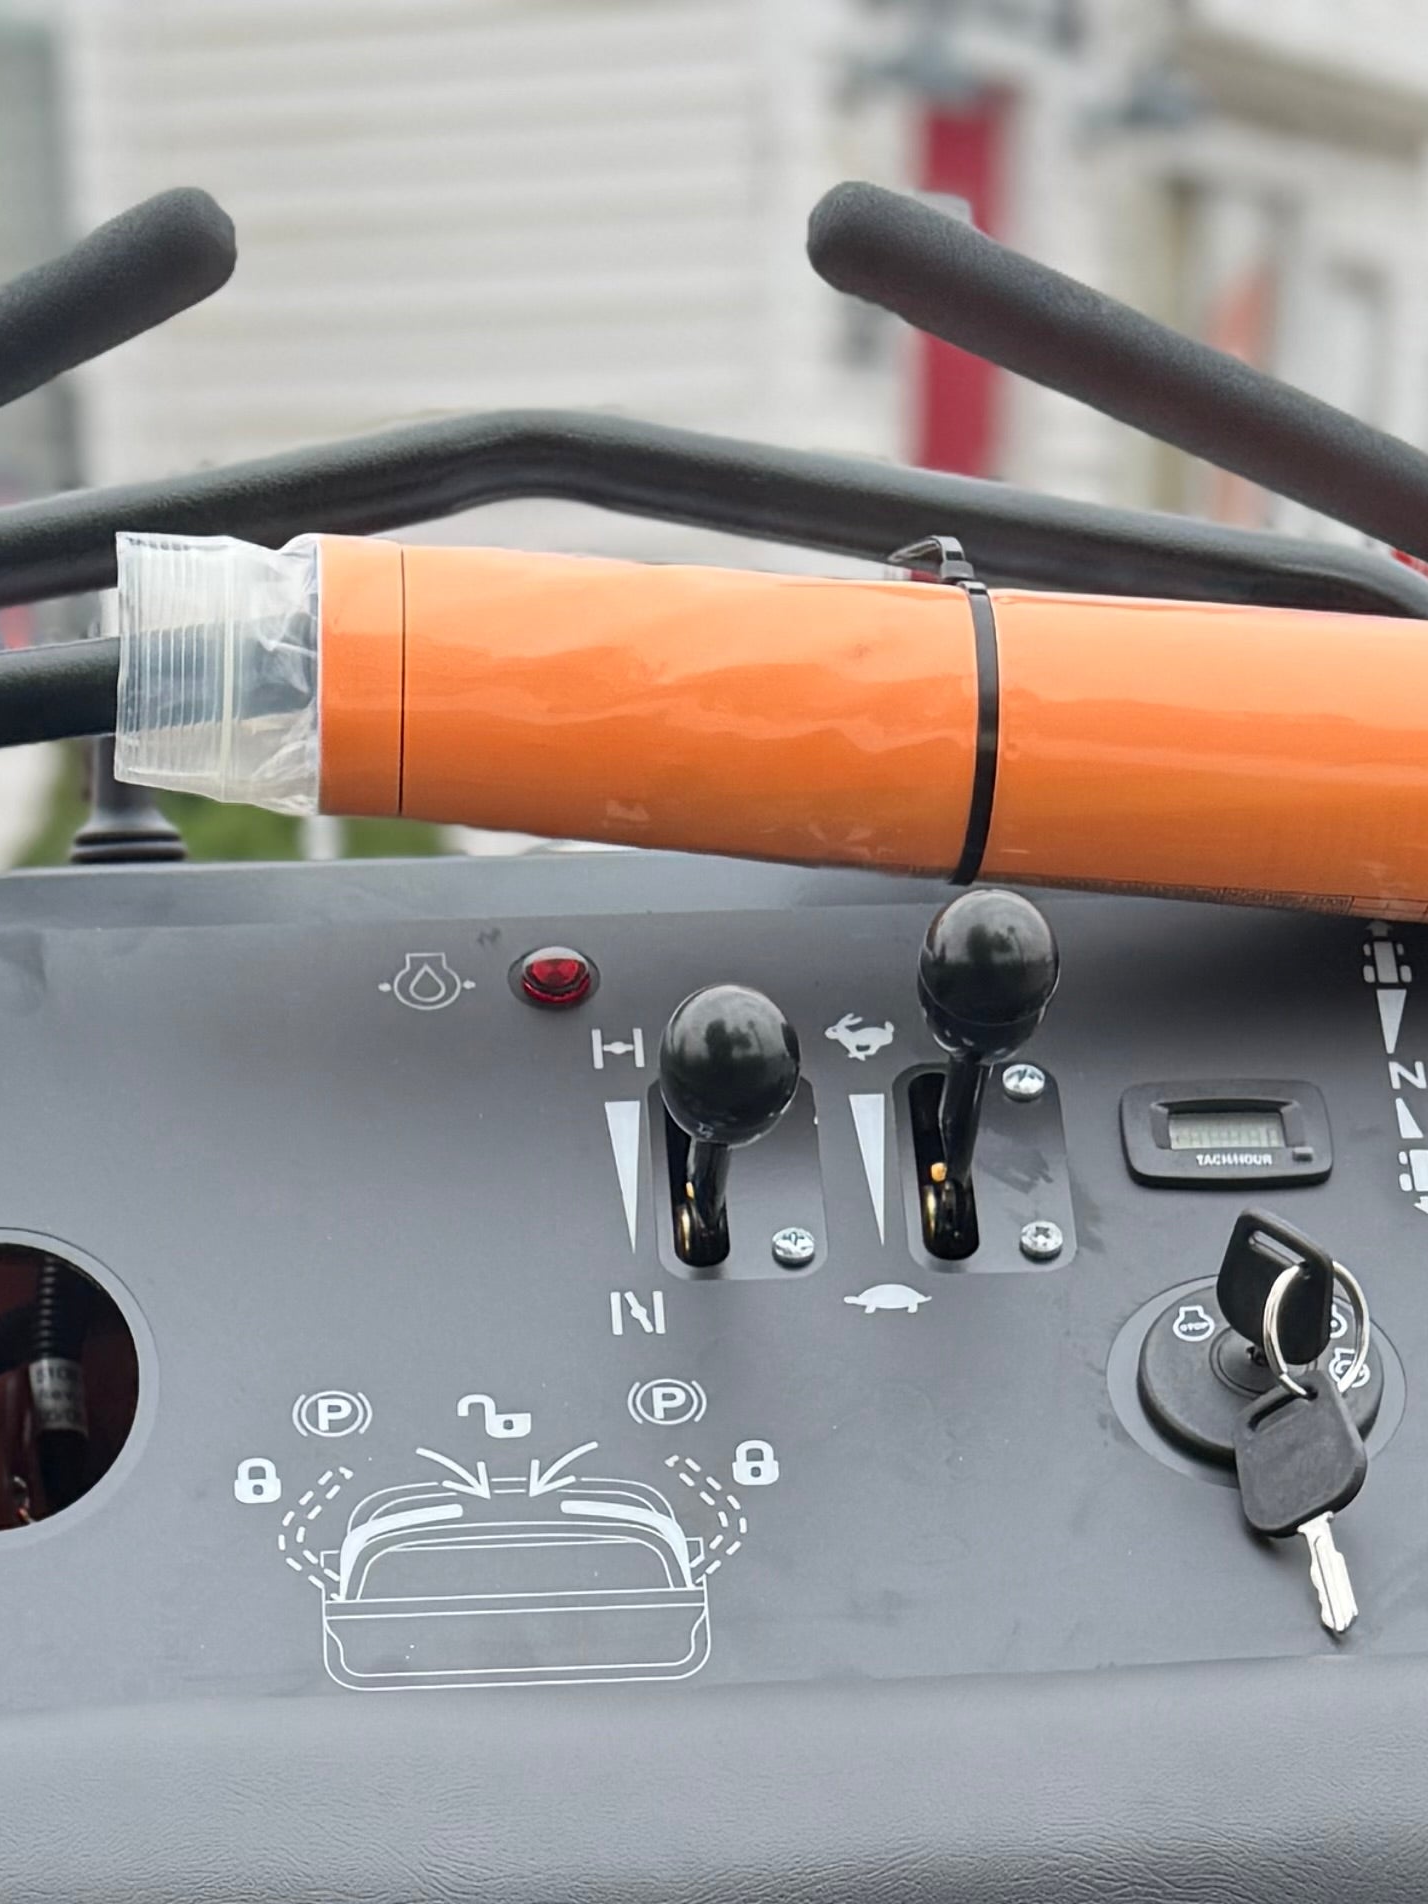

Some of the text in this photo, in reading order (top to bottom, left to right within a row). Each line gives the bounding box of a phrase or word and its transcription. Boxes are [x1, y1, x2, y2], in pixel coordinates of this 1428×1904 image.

[1388, 1061, 1427, 1089] N
[1179, 1322, 1209, 1332] STOP
[317, 1398, 352, 1432] P
[653, 1386, 686, 1419] P
